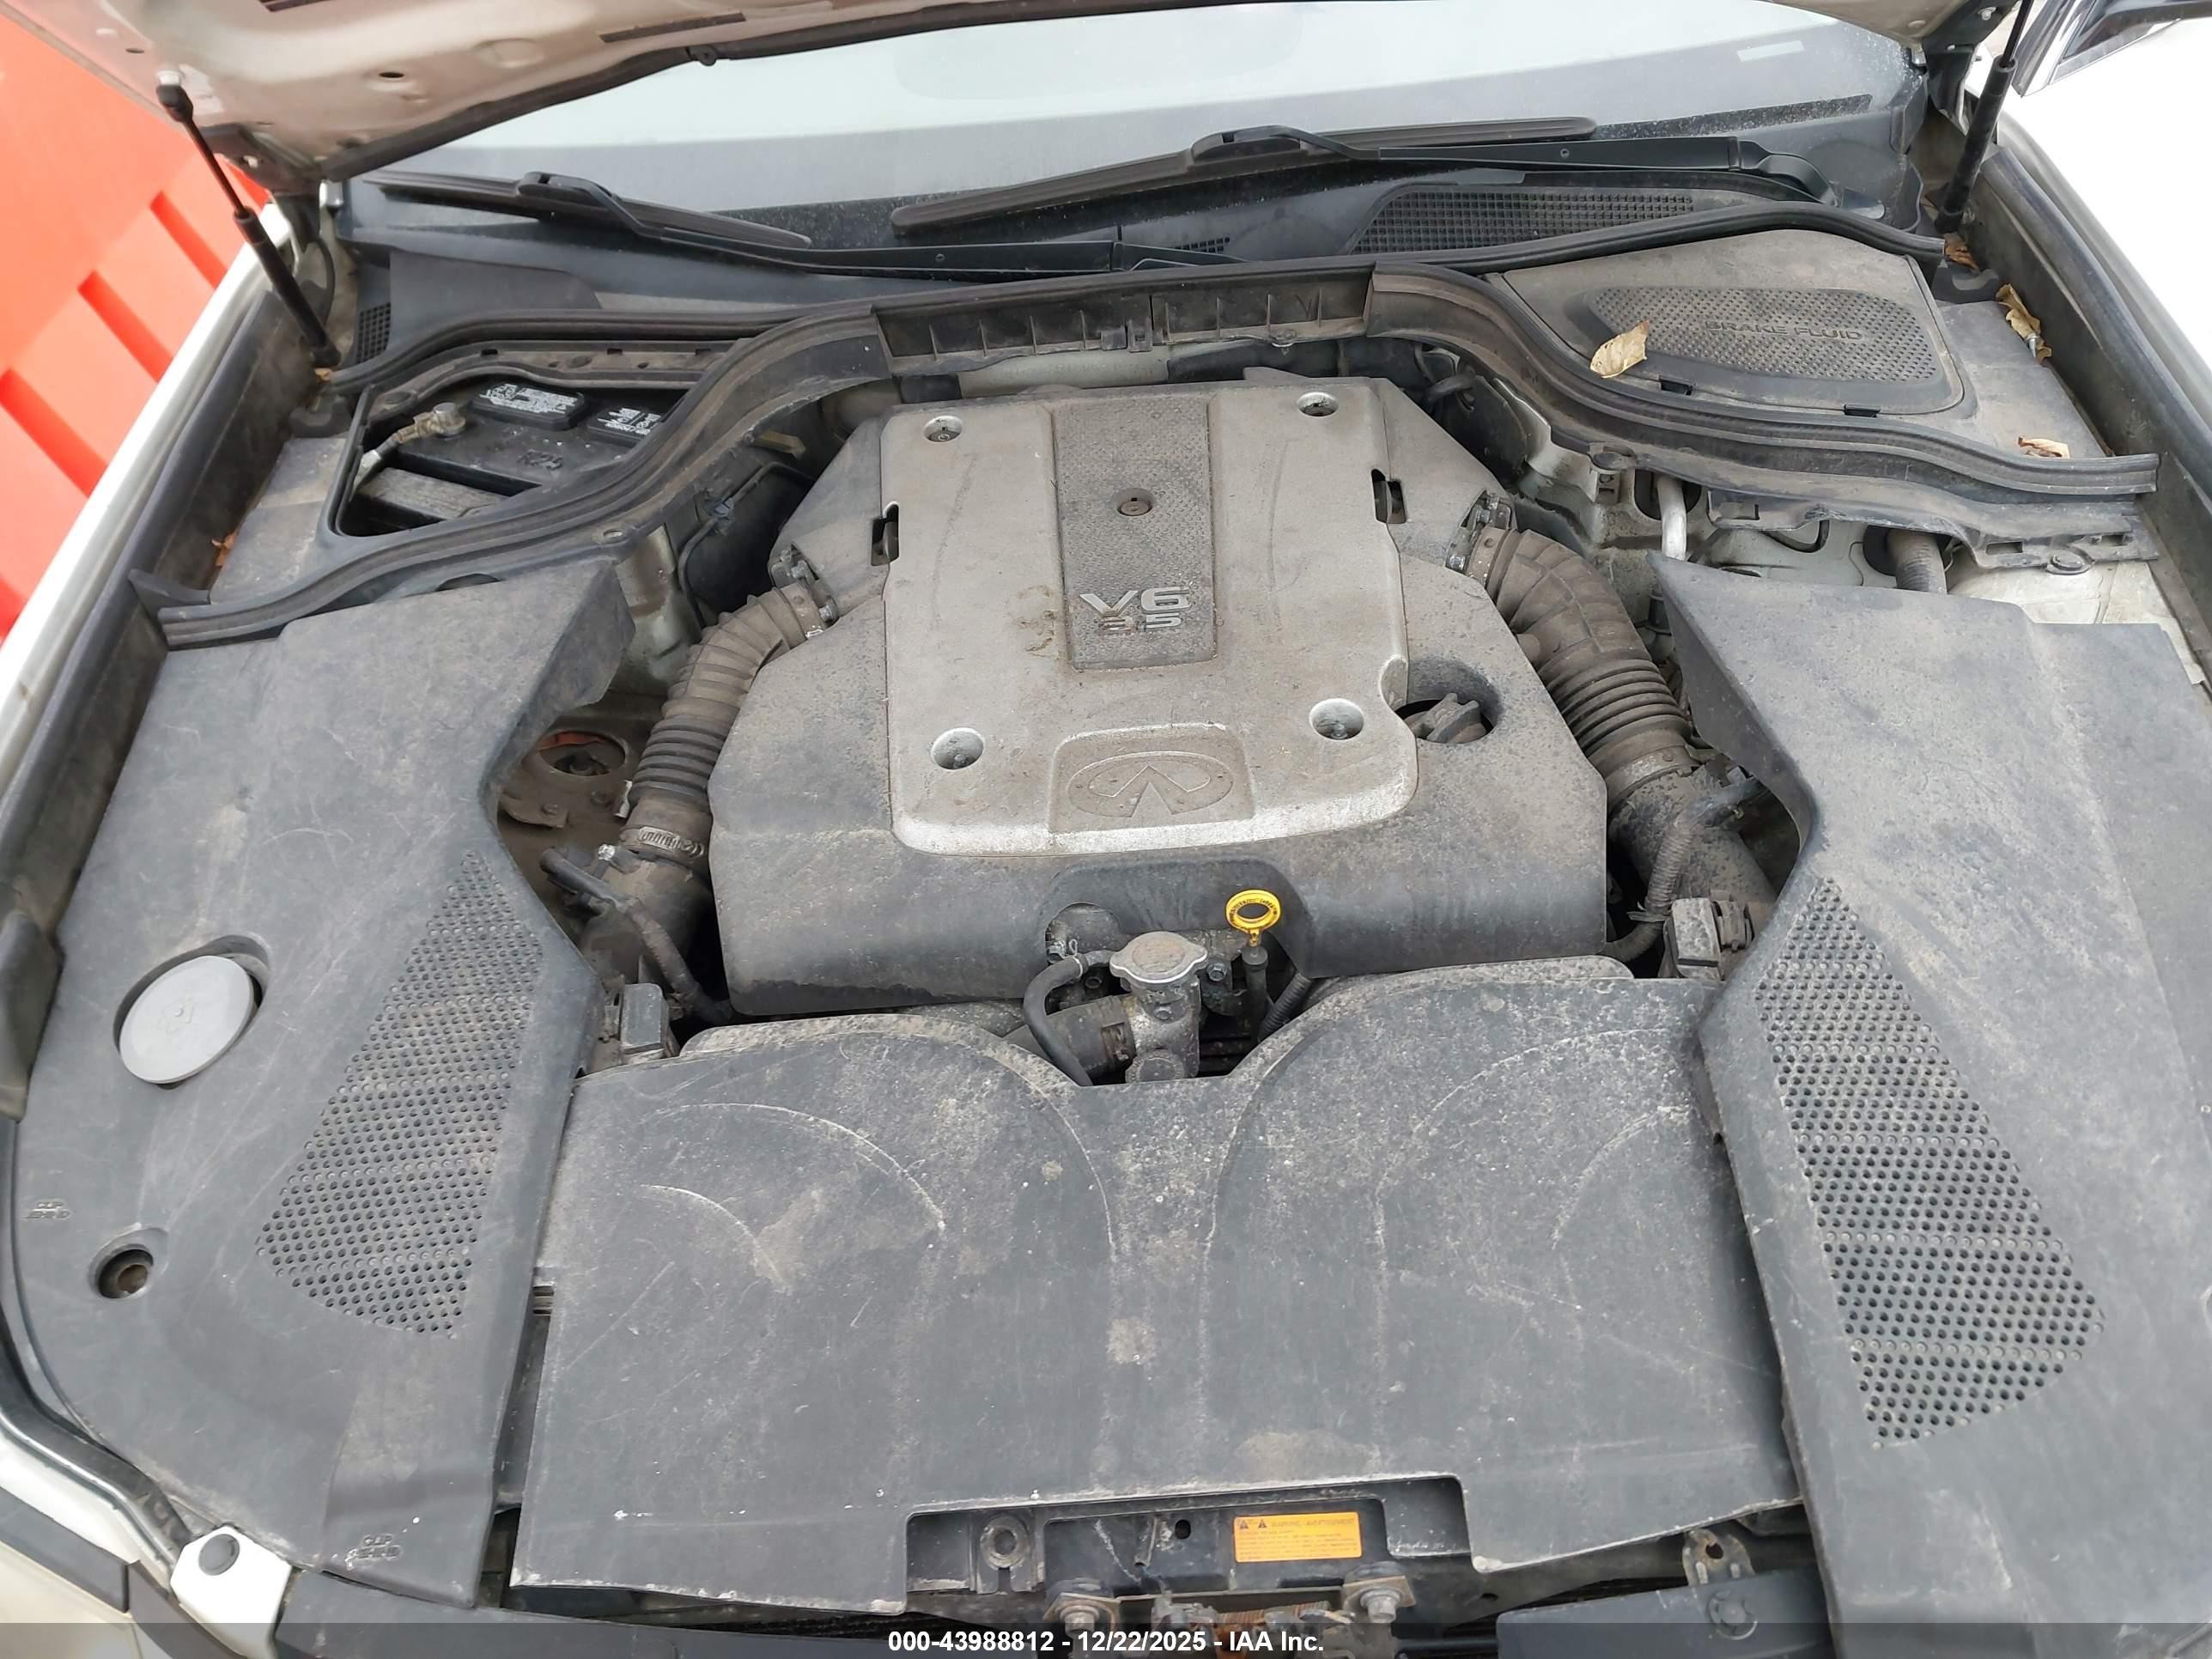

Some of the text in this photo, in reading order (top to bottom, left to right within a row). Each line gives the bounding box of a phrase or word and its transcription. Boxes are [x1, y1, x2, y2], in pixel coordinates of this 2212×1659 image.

[1705, 320, 1863, 340] BRAKE FLUID
[1079, 586, 1191, 617] V6
